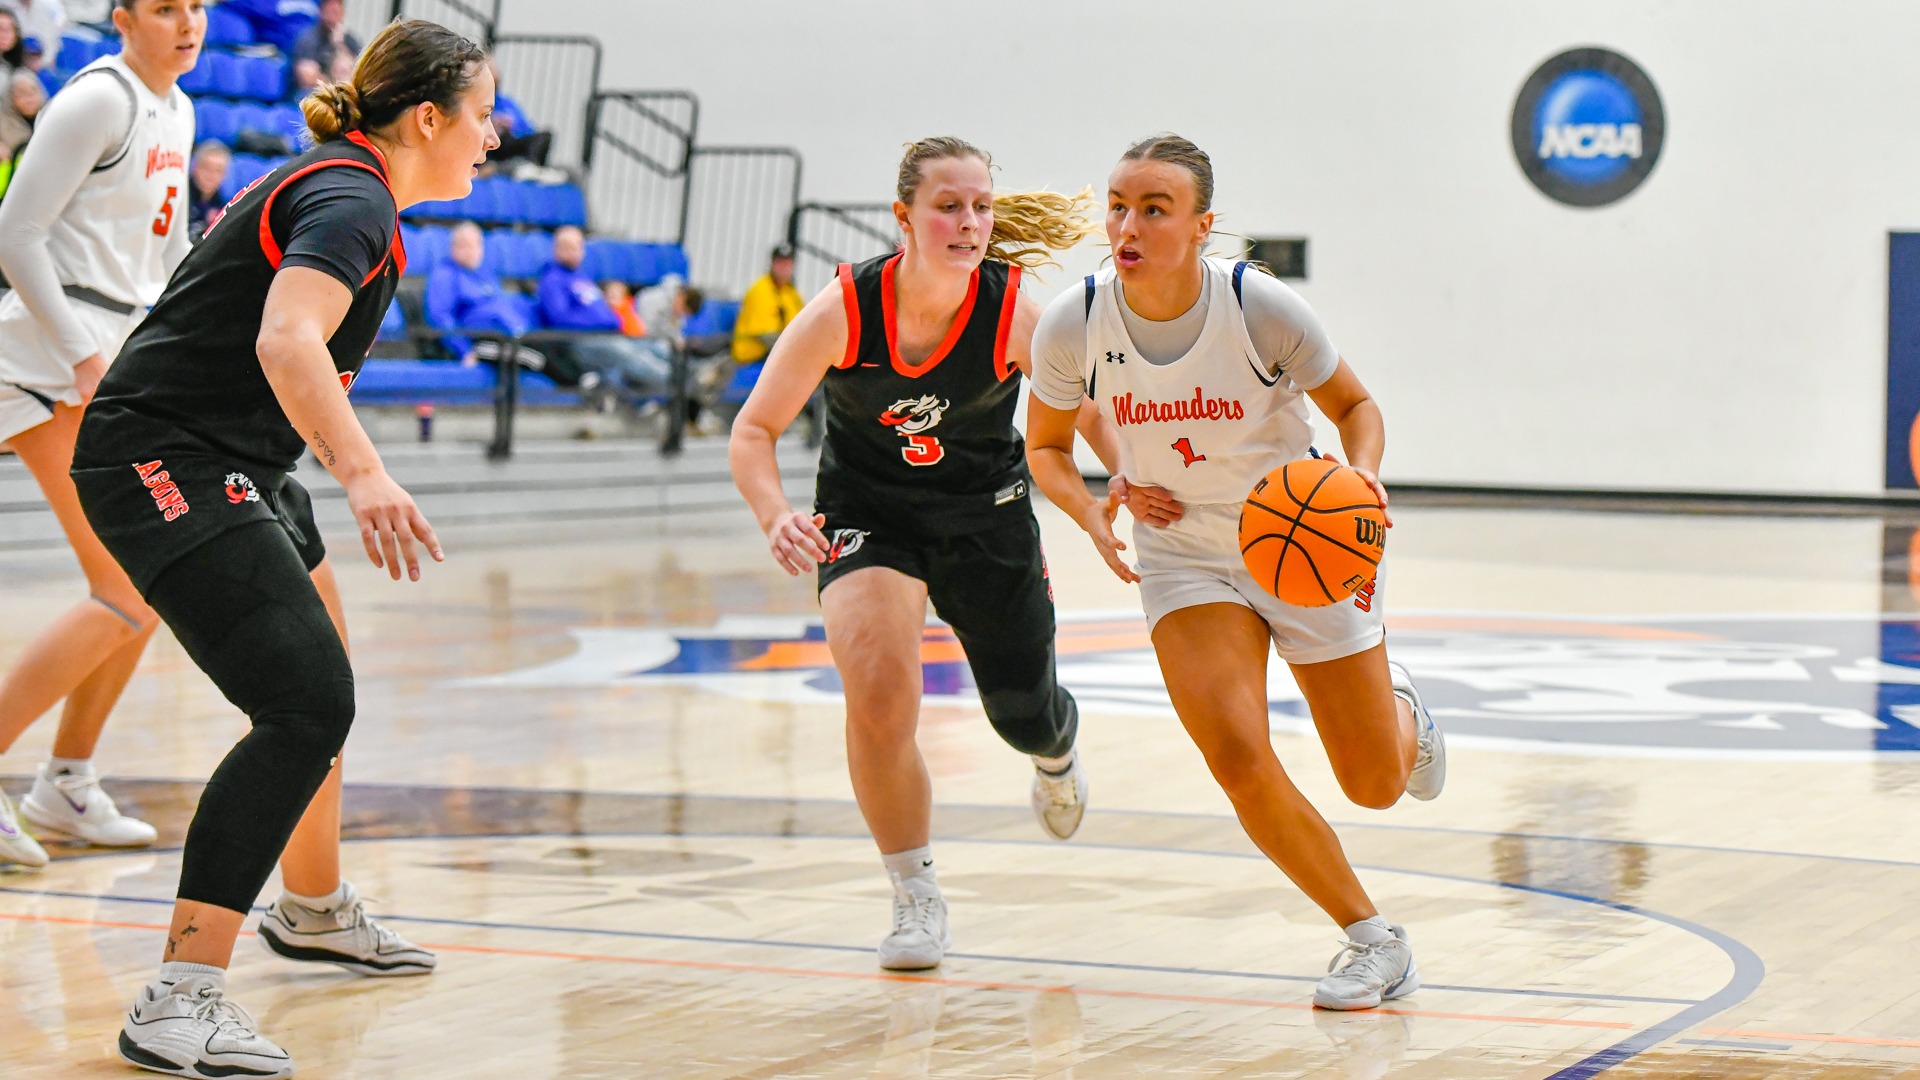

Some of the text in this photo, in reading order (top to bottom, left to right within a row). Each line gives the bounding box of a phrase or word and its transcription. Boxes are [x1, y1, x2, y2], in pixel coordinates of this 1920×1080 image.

[1539, 123, 1643, 159] NCAA
[152, 186, 177, 236] 5
[1112, 386, 1244, 427] Marauders
[1170, 437, 1207, 468] 1
[131, 459, 190, 522] AGONS
[1354, 515, 1386, 550] Wil
